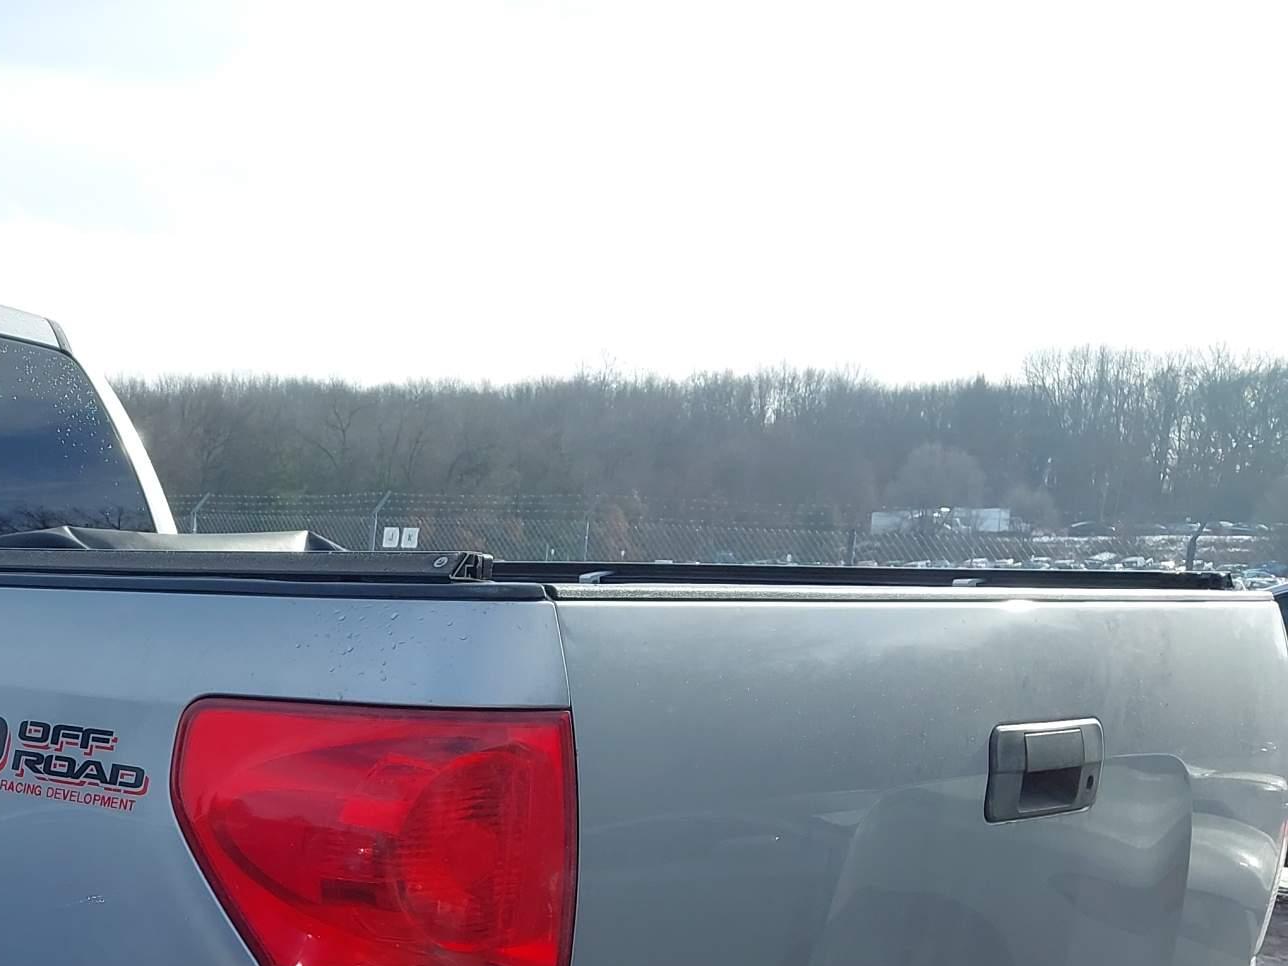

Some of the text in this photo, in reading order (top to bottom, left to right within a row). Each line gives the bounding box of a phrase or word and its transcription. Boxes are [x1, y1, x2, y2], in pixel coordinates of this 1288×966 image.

[17, 720, 118, 756] OFF
[11, 750, 150, 797] ROAD
[0, 779, 43, 797] RACING
[45, 787, 137, 812] DEVELOPMENT
